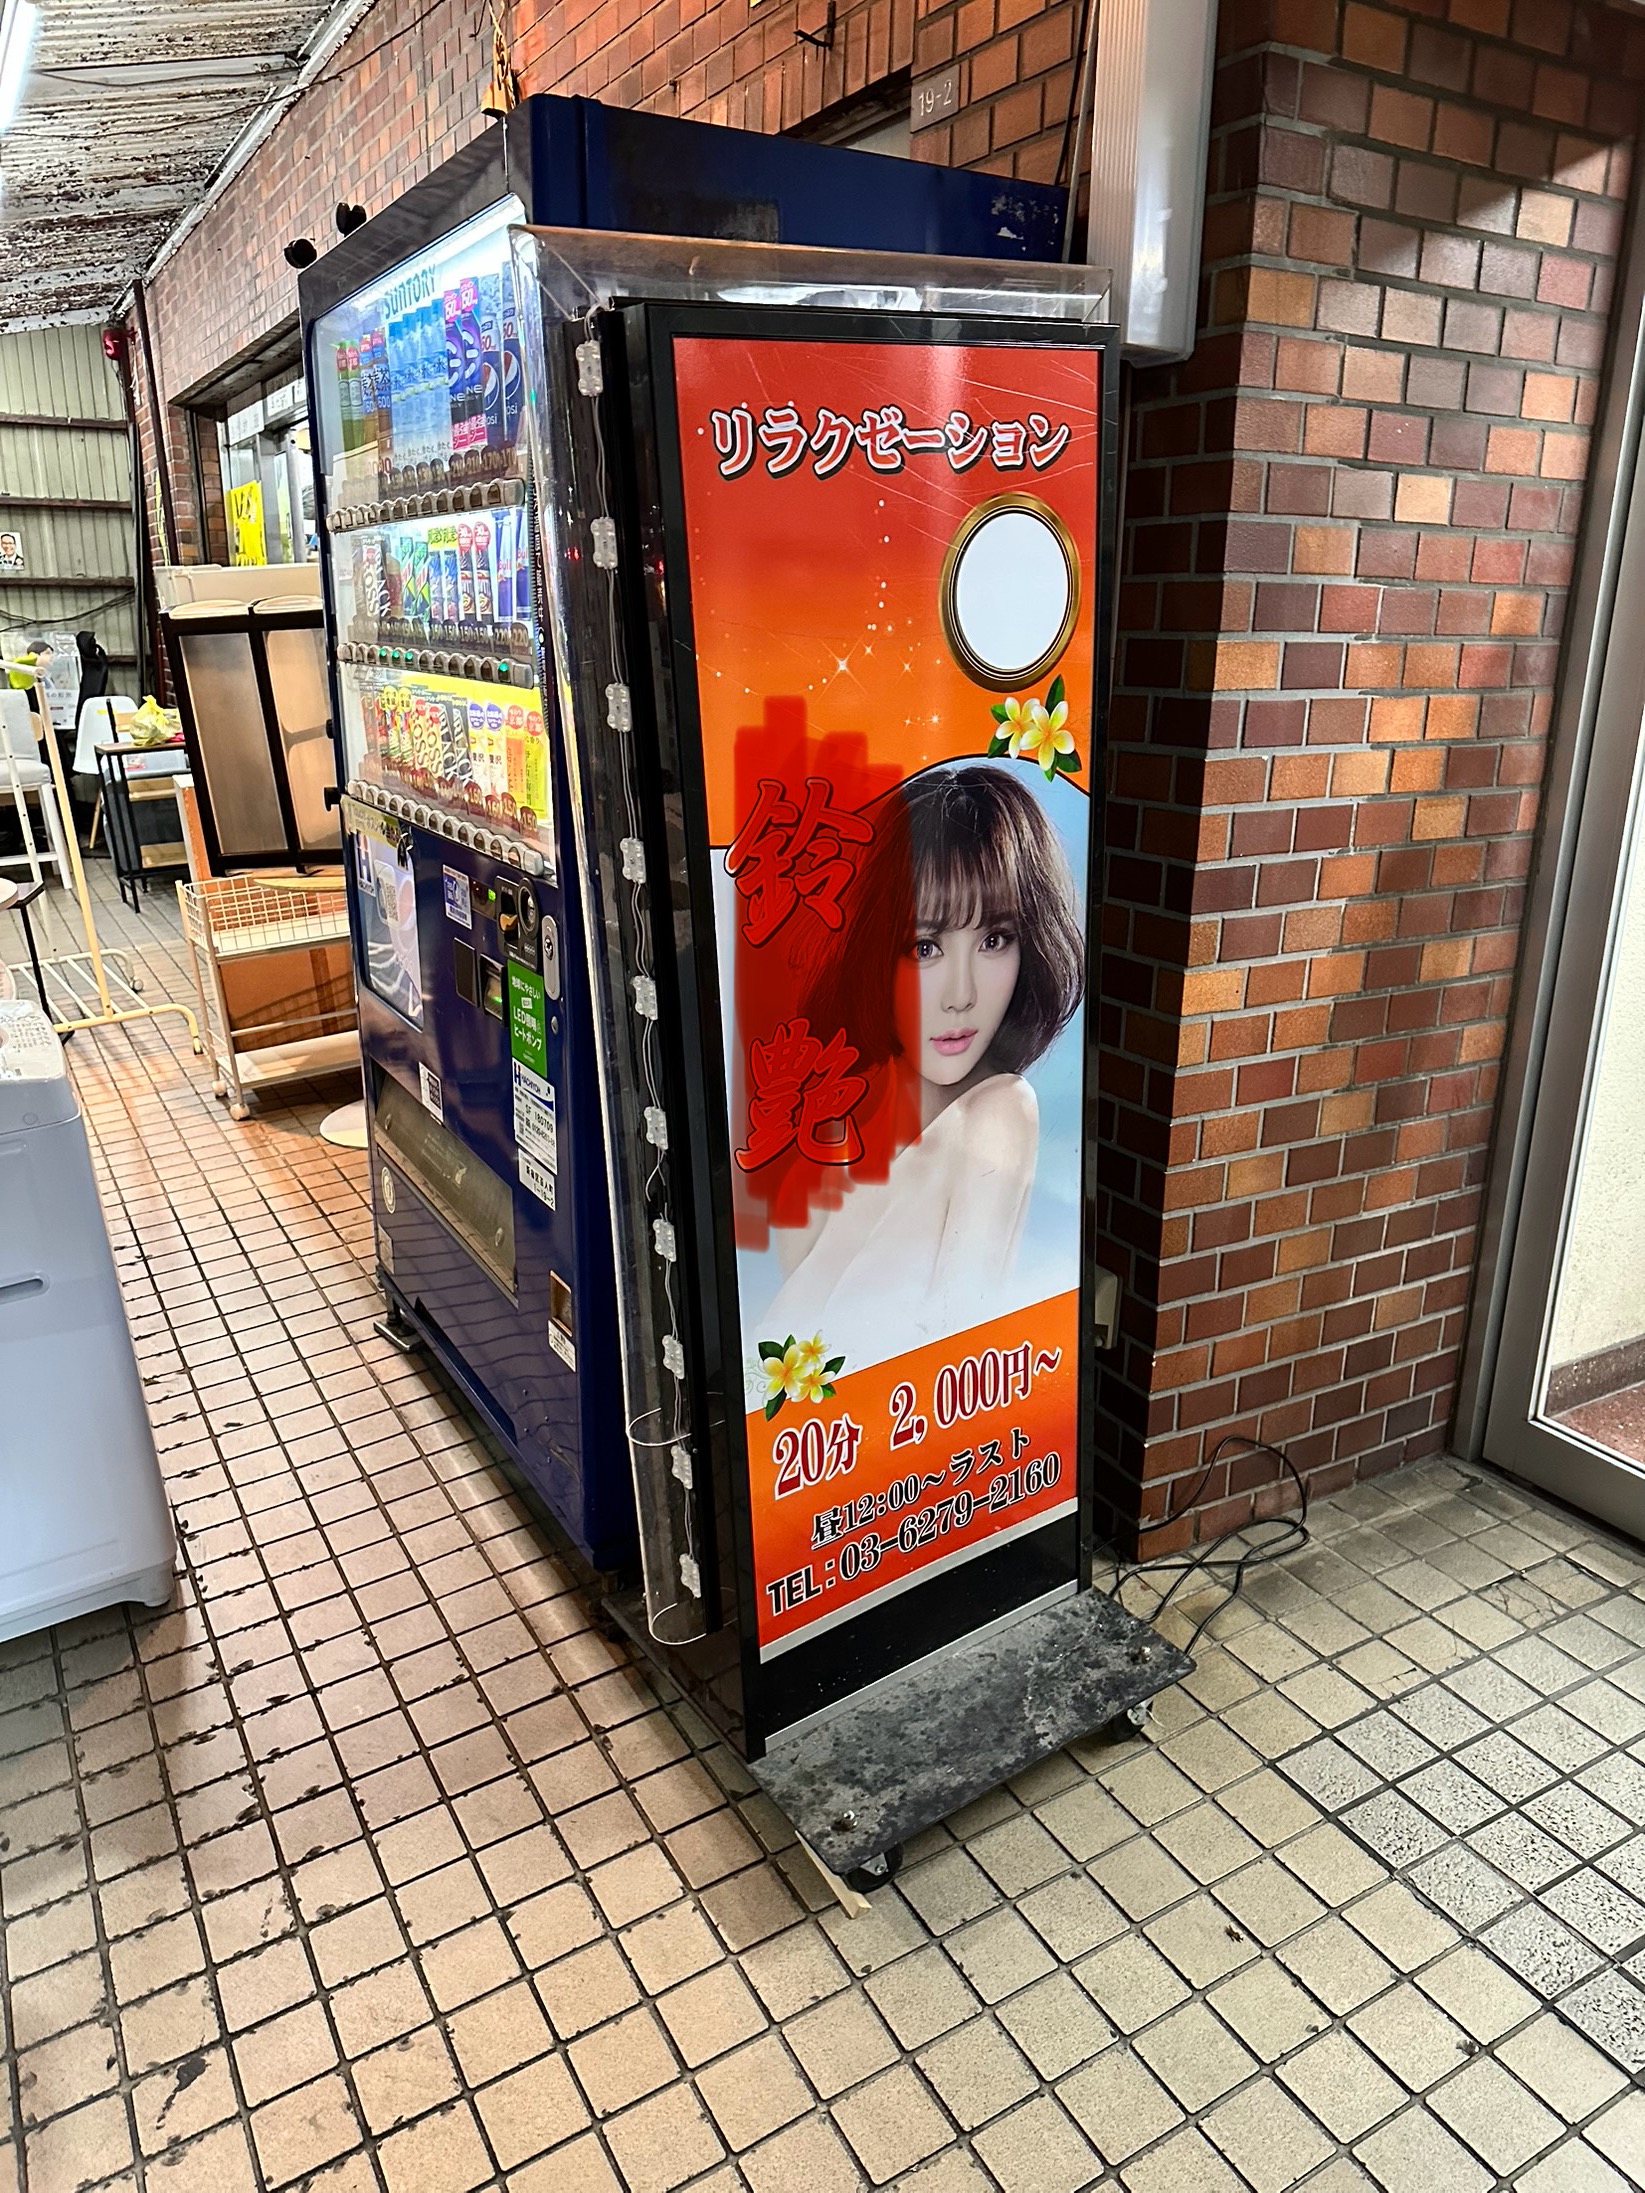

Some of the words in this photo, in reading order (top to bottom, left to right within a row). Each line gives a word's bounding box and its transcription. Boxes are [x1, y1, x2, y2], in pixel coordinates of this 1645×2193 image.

[918, 78, 952, 117] 19-2
[384, 263, 436, 320] SUNTORY
[710, 403, 1072, 482] リラクゼーション
[772, 1413, 863, 1501] 20分
